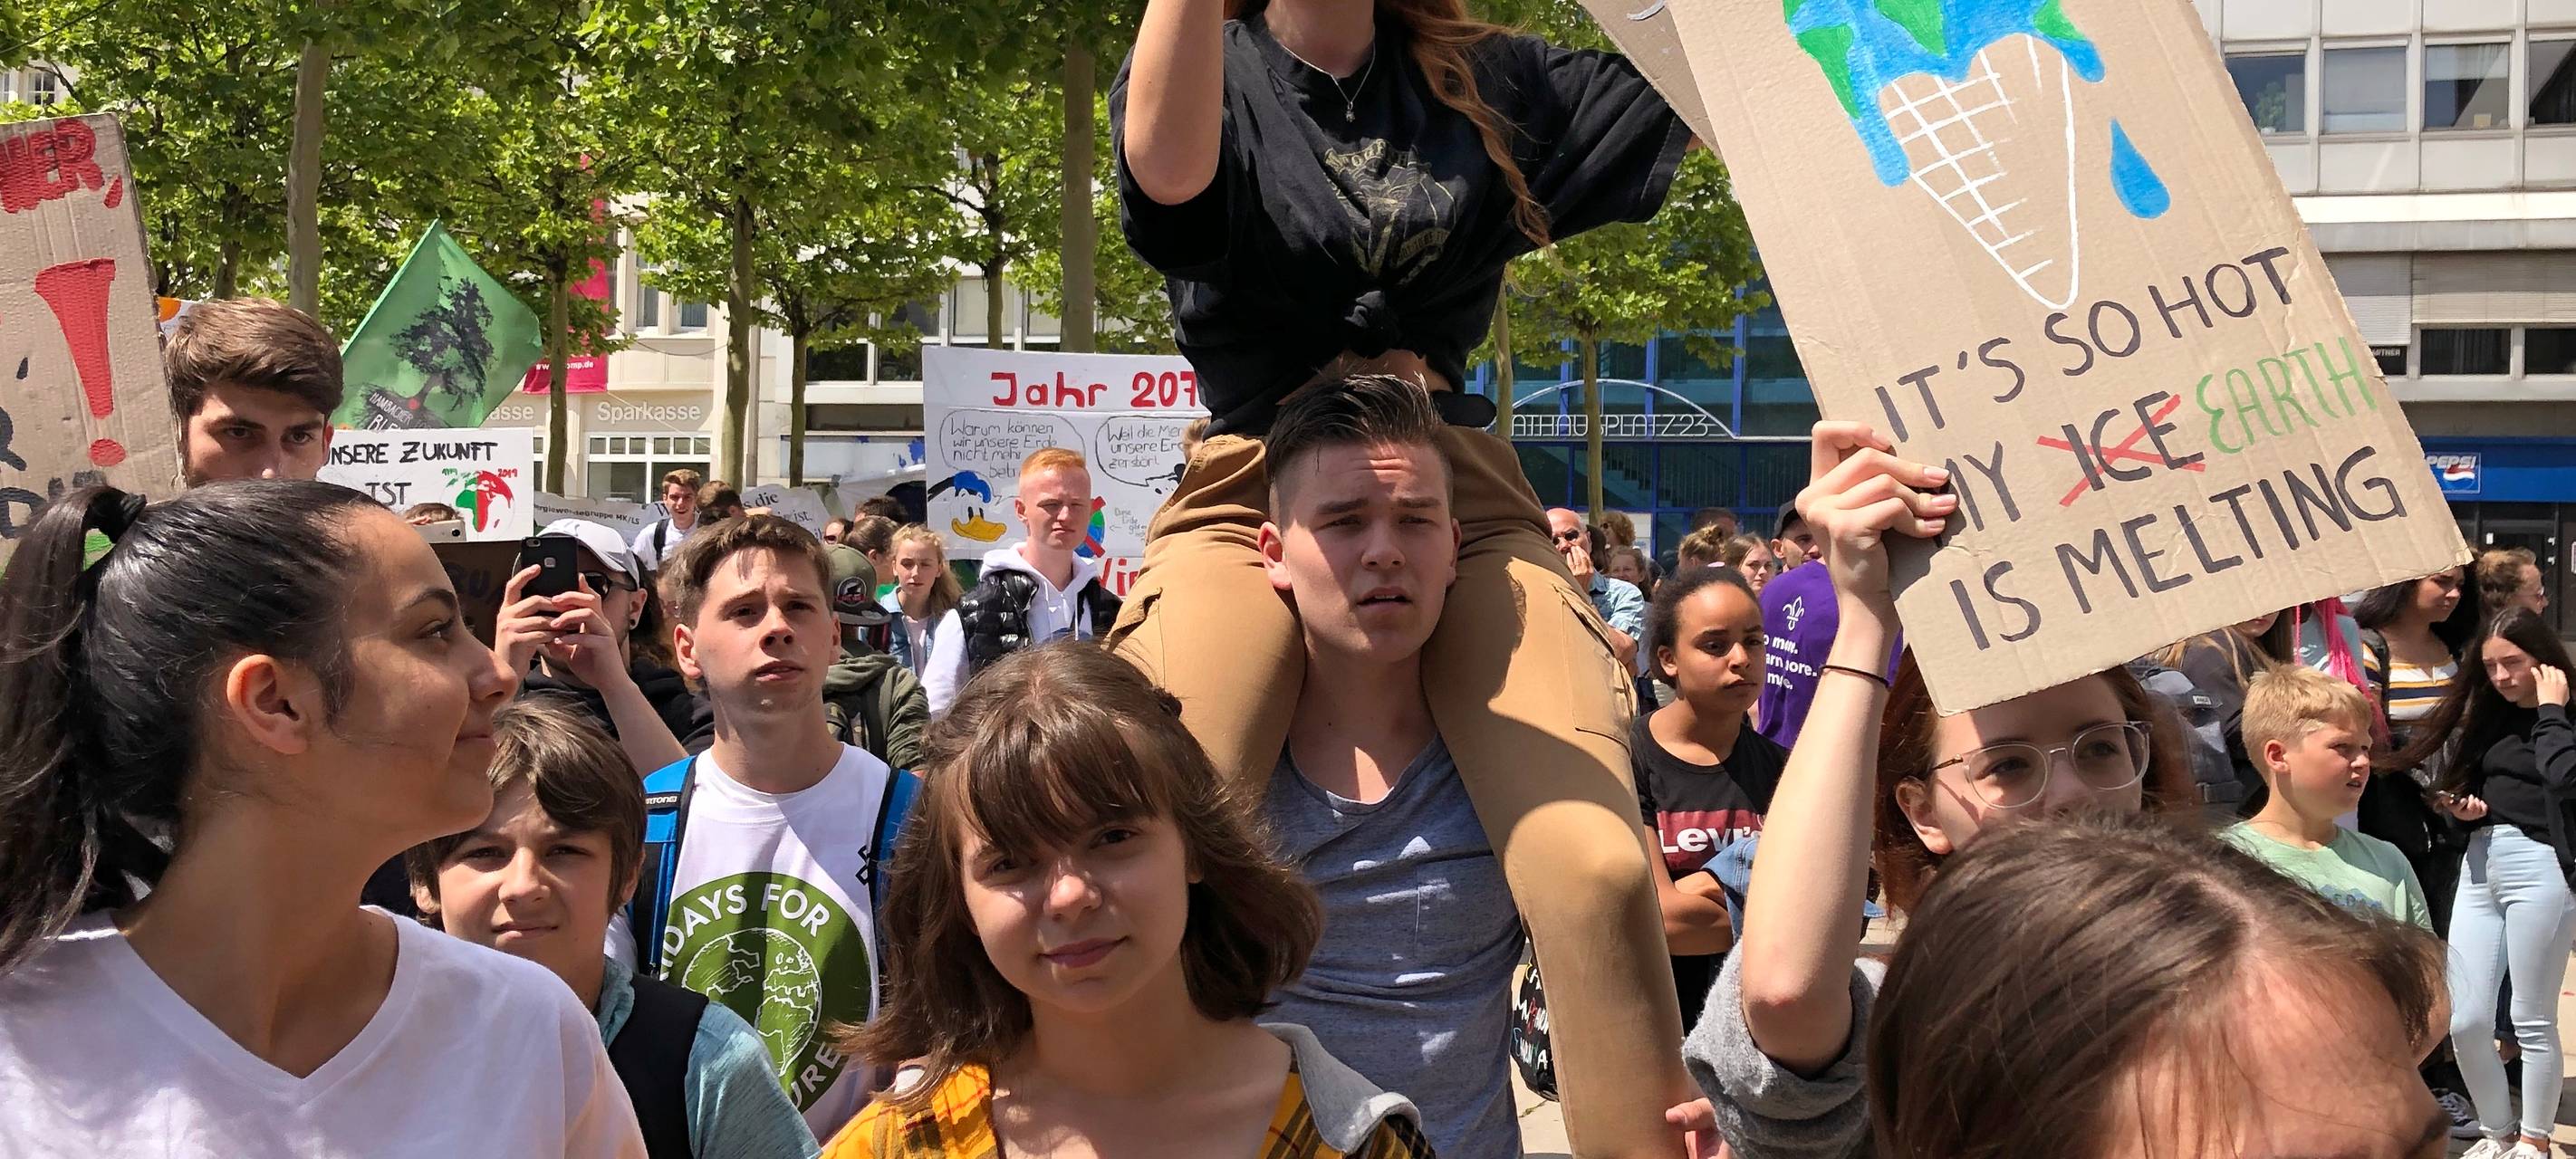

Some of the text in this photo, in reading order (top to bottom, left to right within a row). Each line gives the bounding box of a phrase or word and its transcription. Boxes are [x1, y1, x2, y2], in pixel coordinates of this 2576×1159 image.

[1875, 246, 2290, 443] IT'S SO HOT
[991, 370, 1197, 407] Jahr 207
[492, 405, 535, 422] asse
[597, 401, 701, 424] Sparkasse
[2062, 390, 2205, 492] ICE
[2196, 336, 2378, 455] EARTH
[950, 417, 1053, 436] Warum können
[1511, 414, 1676, 436] ATHAUPLATZ
[329, 442, 498, 465] NSERE ZUKUNFT
[1110, 443, 1157, 454] unsere
[2426, 455, 2477, 469] PEPSI
[365, 482, 412, 506] IST
[1949, 445, 2408, 651] IS MELTING
[1658, 826, 1764, 854] Lev'
[760, 883, 831, 937] FOR
[789, 1040, 841, 1107] URE
